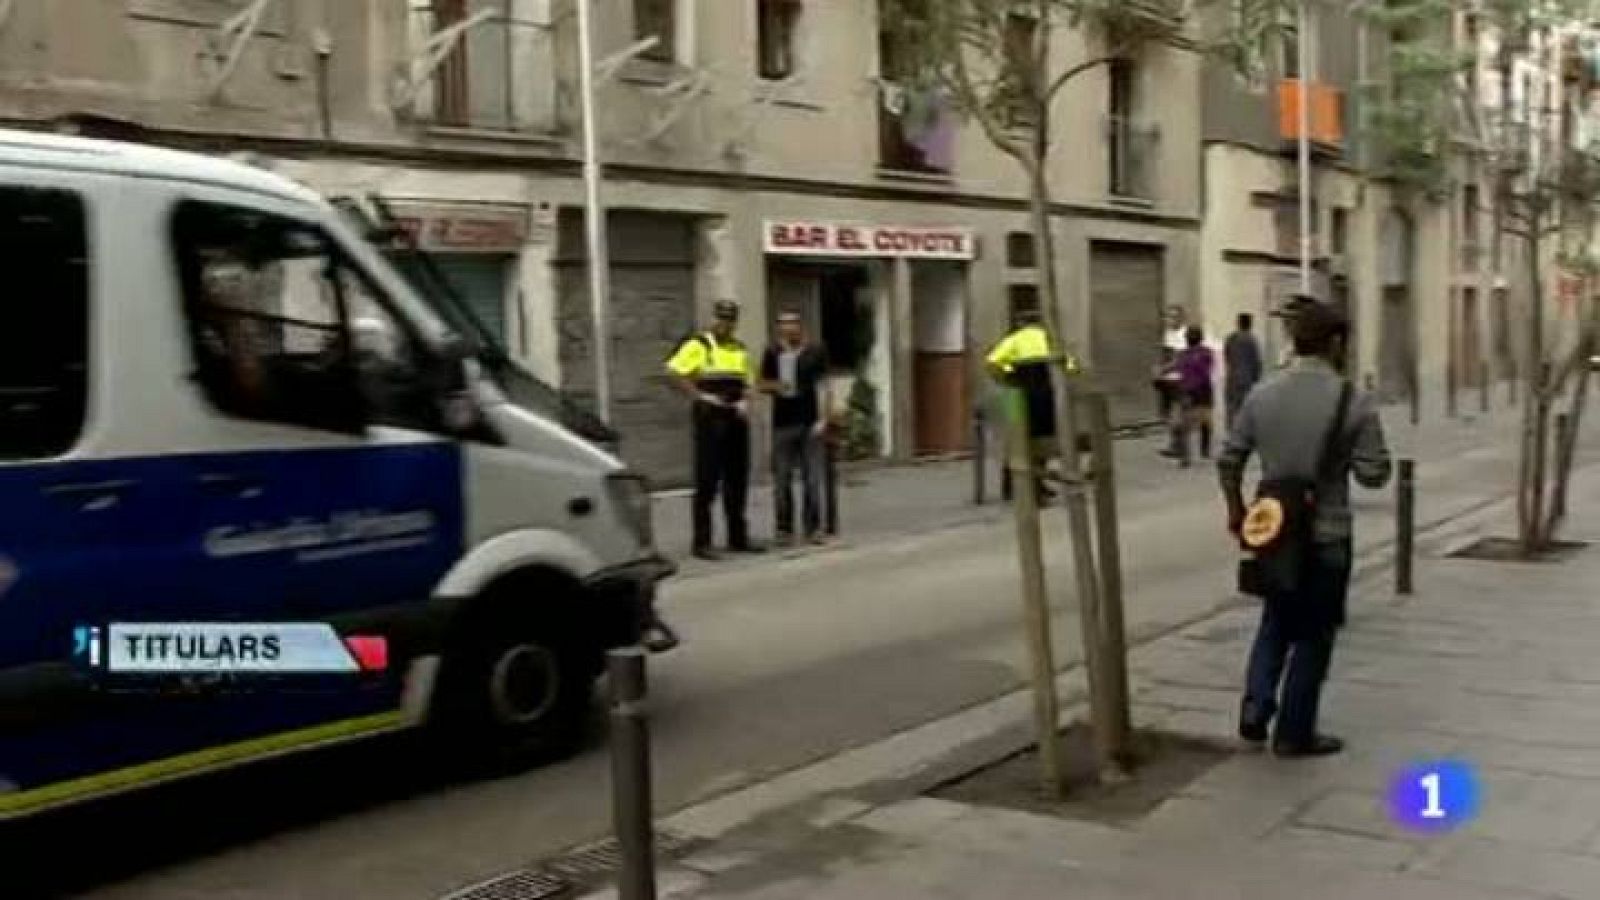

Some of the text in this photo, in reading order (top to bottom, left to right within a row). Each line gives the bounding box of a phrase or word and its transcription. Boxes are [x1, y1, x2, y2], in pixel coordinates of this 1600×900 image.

[770, 224, 965, 252] BAR EL COYOTE
